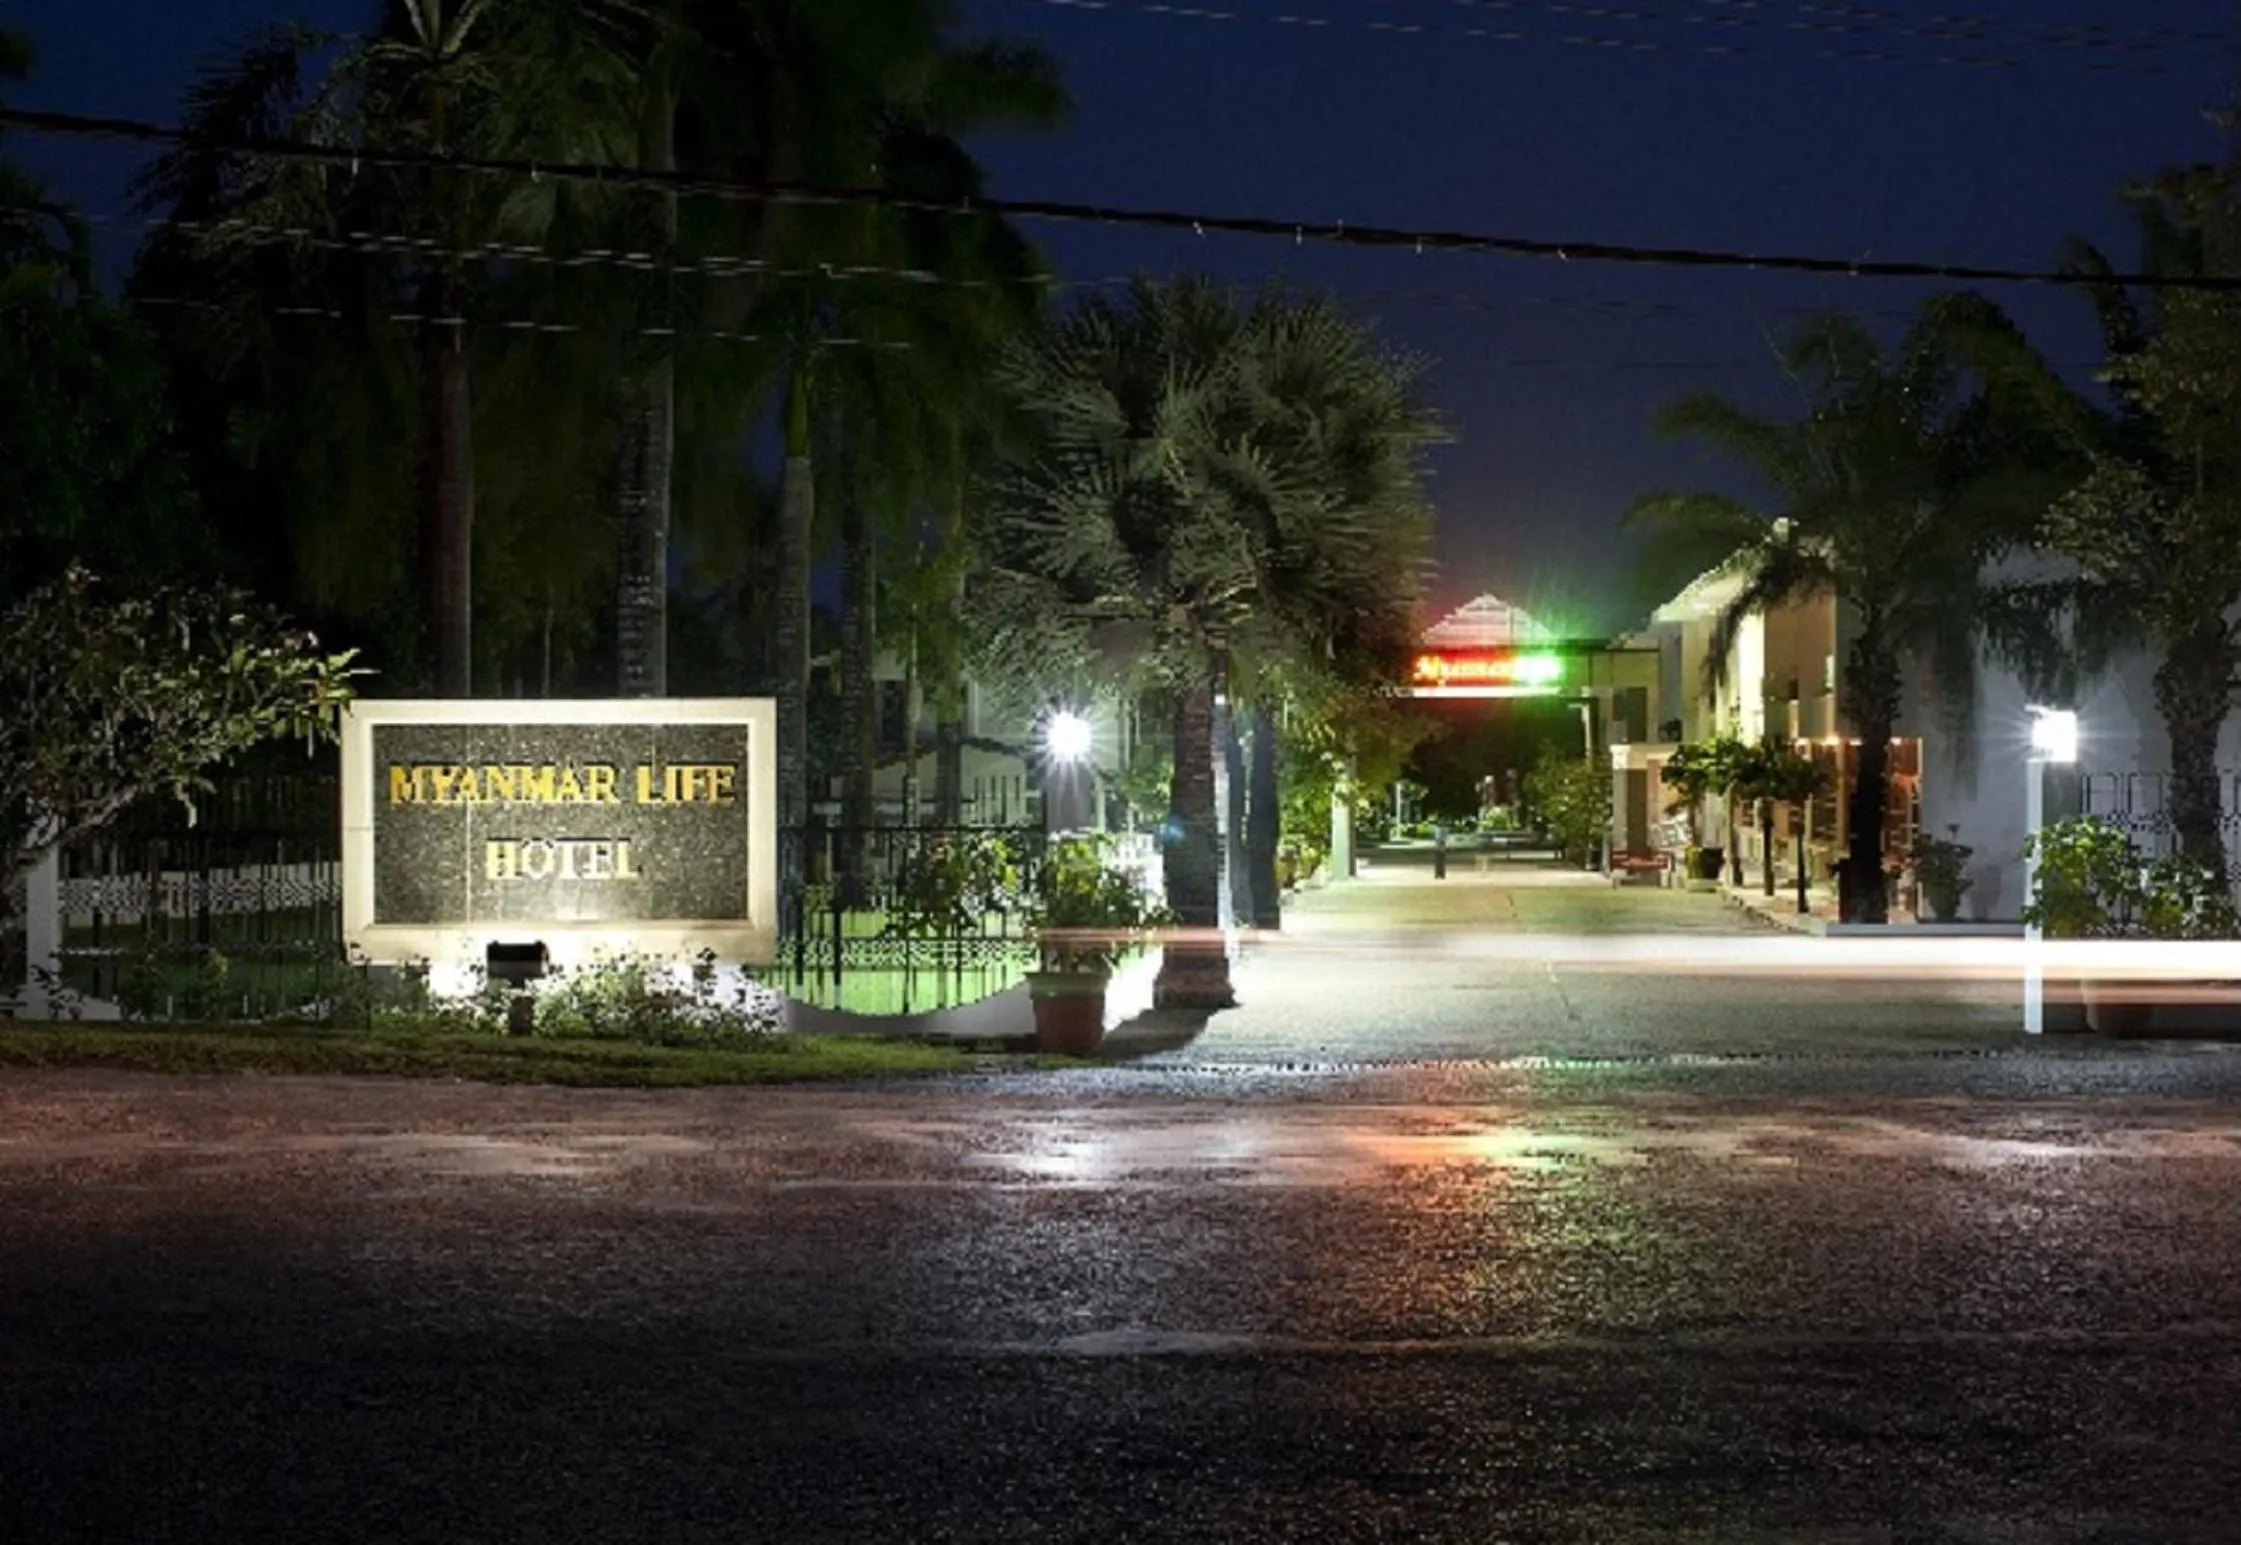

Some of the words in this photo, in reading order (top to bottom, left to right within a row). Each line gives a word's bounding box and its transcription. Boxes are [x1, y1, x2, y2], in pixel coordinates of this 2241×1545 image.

[388, 763, 621, 804] MYANMAR
[637, 763, 737, 804] LIFE
[486, 838, 641, 879] HOTEL
